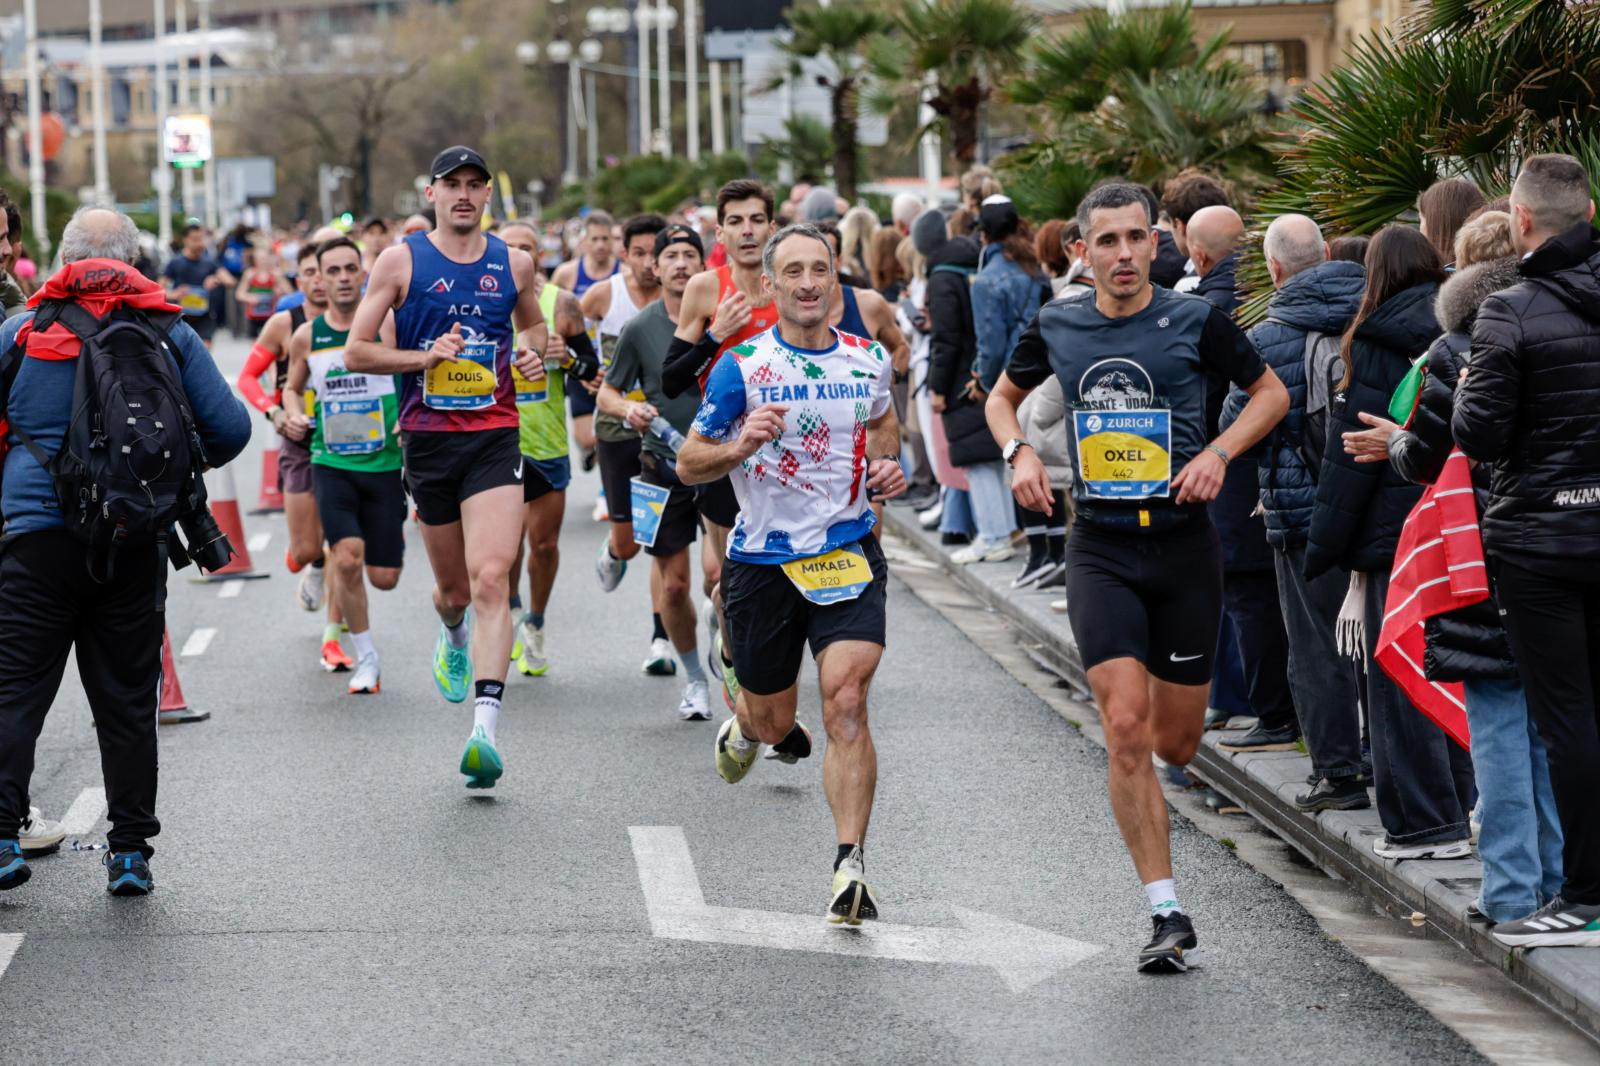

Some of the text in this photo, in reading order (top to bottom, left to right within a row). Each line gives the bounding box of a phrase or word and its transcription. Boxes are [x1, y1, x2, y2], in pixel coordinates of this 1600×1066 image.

[85, 267, 126, 282] RPM
[447, 304, 482, 317] ACA
[457, 347, 486, 357] URICH
[448, 371, 484, 382] LOUIS
[759, 382, 871, 403] TEAM XURIAK
[1106, 417, 1154, 429] ZURICH
[1104, 449, 1147, 462] OXEL
[1112, 468, 1135, 480] 442
[801, 558, 858, 574] MIKAEL
[819, 576, 841, 587] 820
